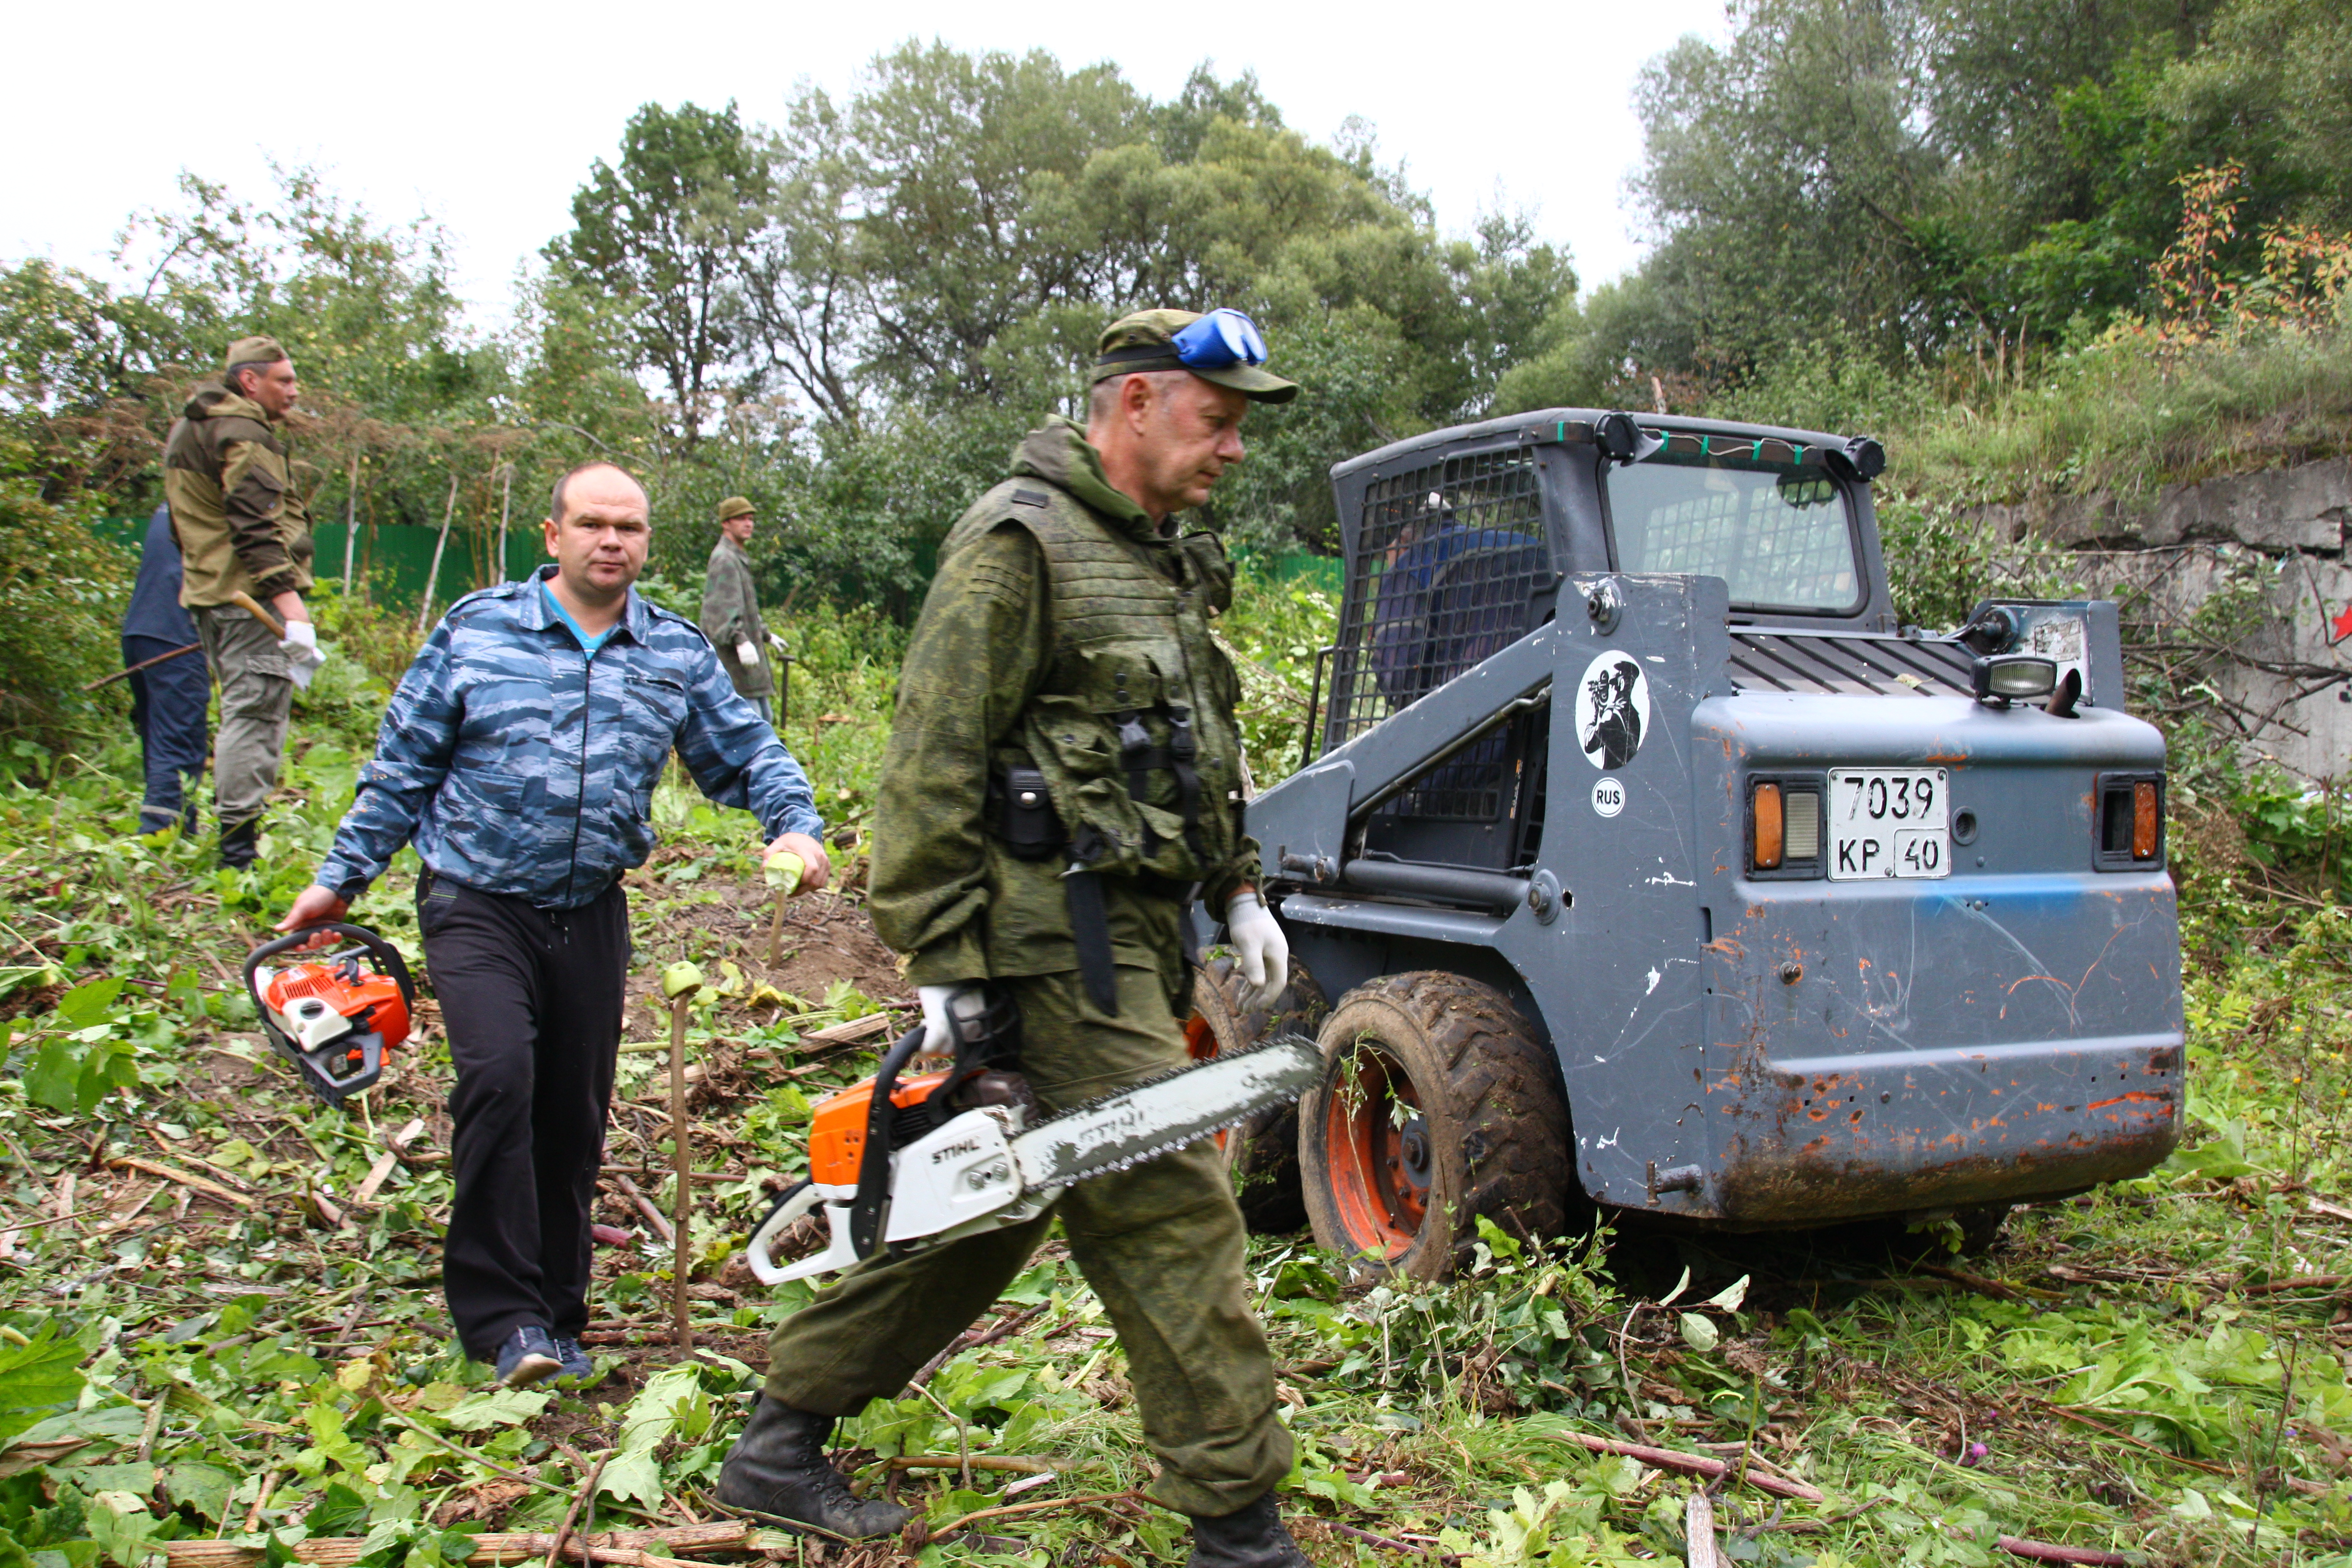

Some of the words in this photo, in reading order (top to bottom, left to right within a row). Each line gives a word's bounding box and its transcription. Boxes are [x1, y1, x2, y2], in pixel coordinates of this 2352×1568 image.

[1596, 789, 1620, 805] RUS
[1845, 777, 1933, 819] 7039
[1904, 837, 1939, 871] 40
[932, 1138, 981, 1164] STIHL
